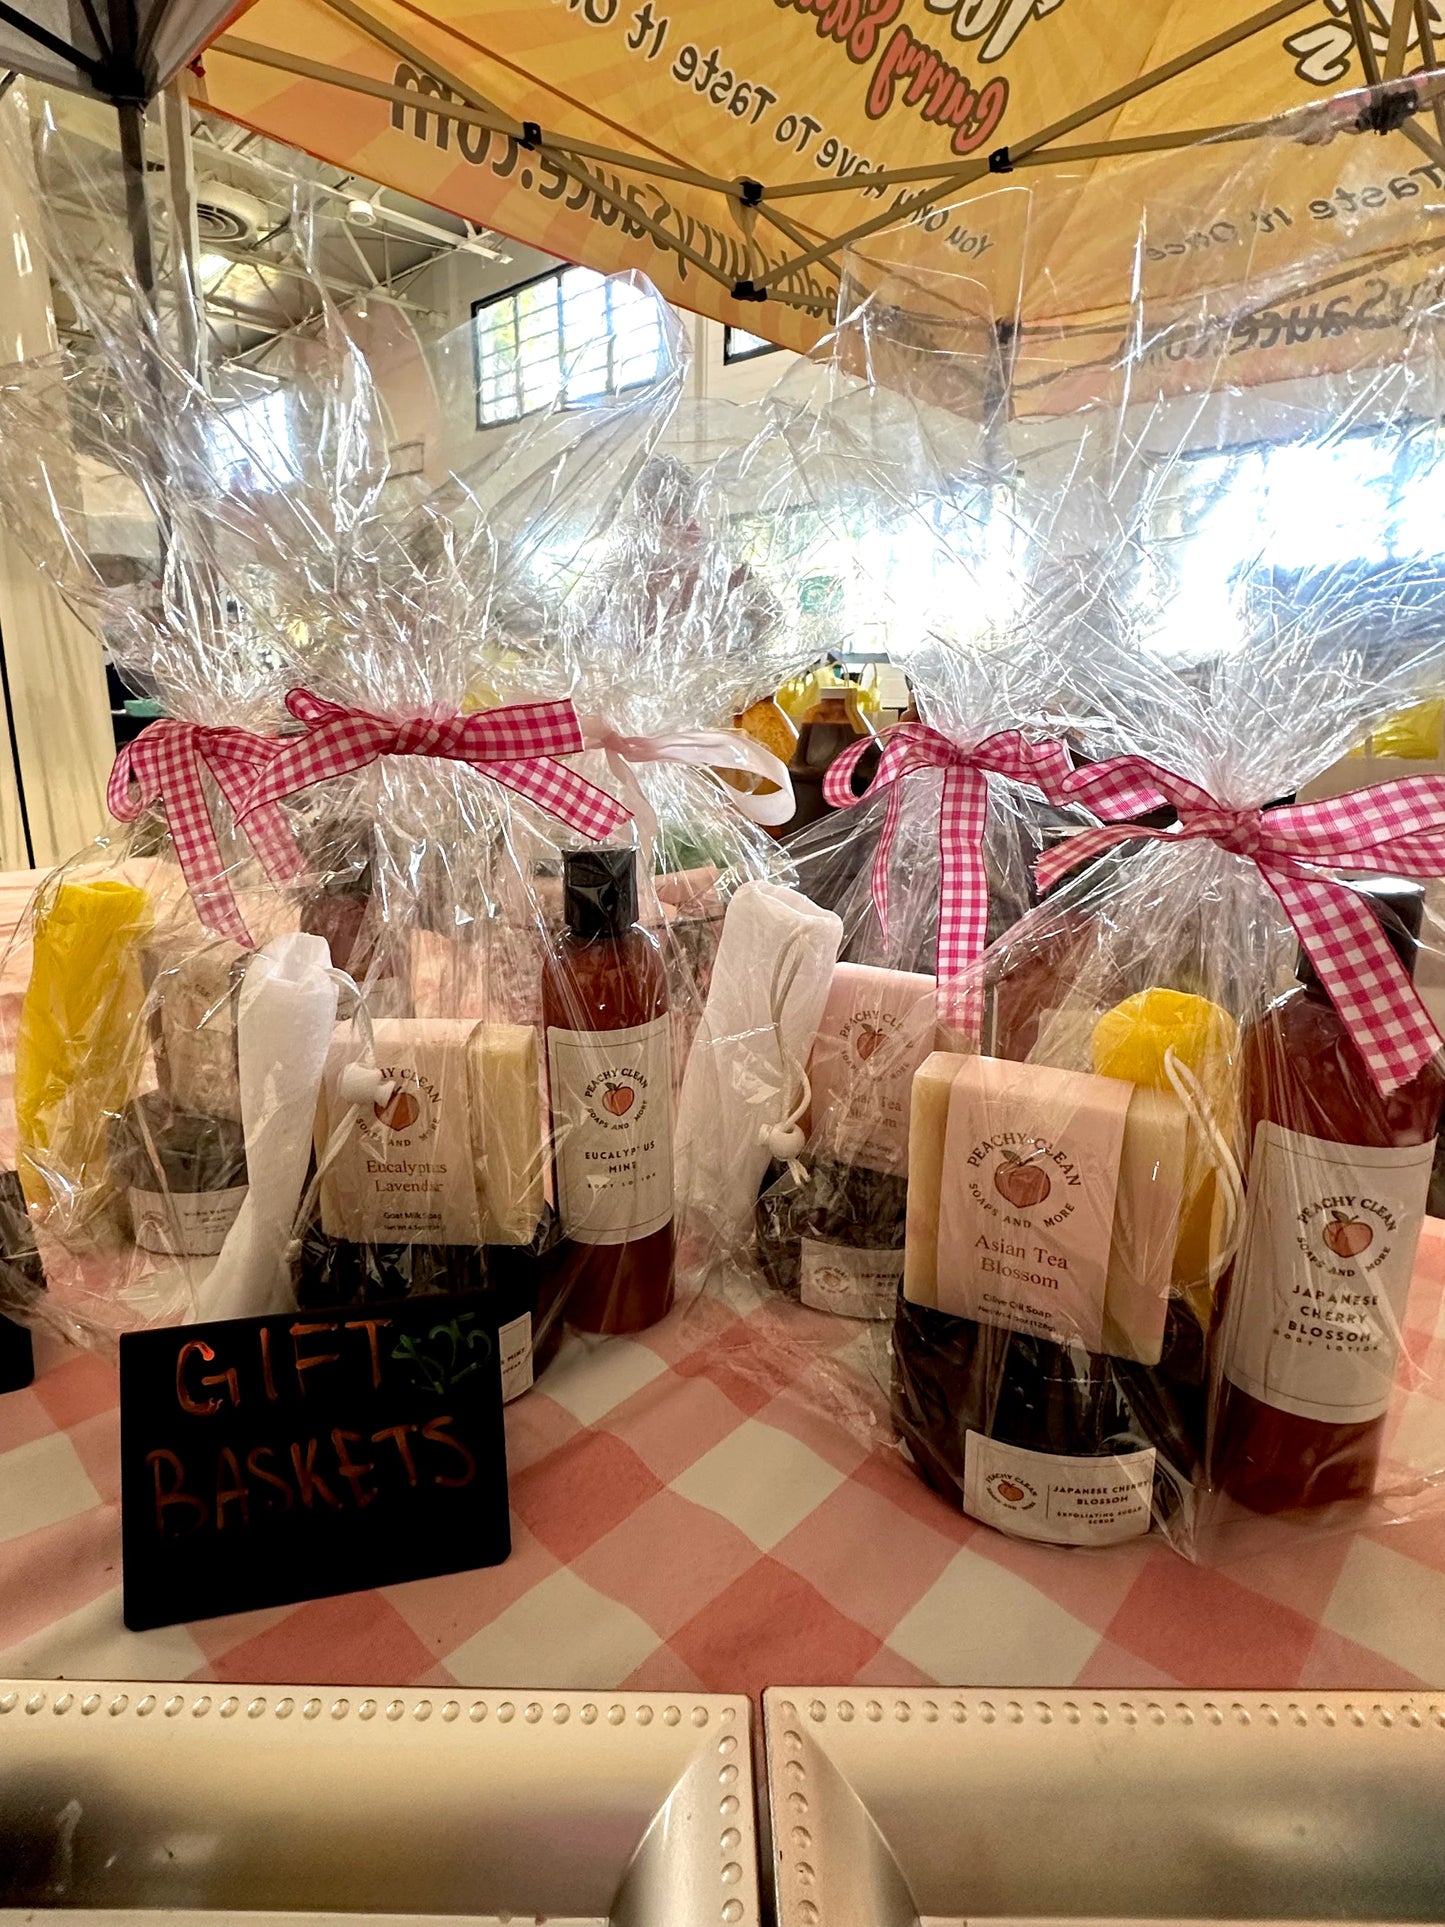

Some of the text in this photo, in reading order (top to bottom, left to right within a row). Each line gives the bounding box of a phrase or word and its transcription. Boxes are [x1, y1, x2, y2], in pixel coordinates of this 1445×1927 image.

[401, 1068, 442, 1104] CLEAN
[585, 1067, 649, 1098] PEACHY CLEAN
[611, 1122, 630, 1131] AND
[388, 1139, 411, 1147] AND
[585, 1140, 655, 1160] EUCALYPUS
[366, 1160, 448, 1177] Eucalyptus
[967, 1132, 1082, 1187] PEACHY CLEAN
[968, 1182, 1076, 1229] SOAPS AND MORE
[1297, 1195, 1397, 1232] PEACHY CLEAN
[974, 1234, 1069, 1270] Asian Tea
[1297, 1236, 1391, 1277] SOAPS AND MORE
[981, 1256, 1059, 1290] Blossom
[1292, 1284, 1379, 1306] JAPANESE
[1026, 1304, 1052, 1319] Soap
[1300, 1305, 1367, 1324] CHERRY
[1288, 1320, 1372, 1342] BLOSSOM
[176, 1319, 393, 1416] GIFT
[145, 1415, 477, 1537] BASKETS
[1053, 1480, 1149, 1495] JAPANESE CHERRY
[1077, 1495, 1129, 1505] BLOSSOM
